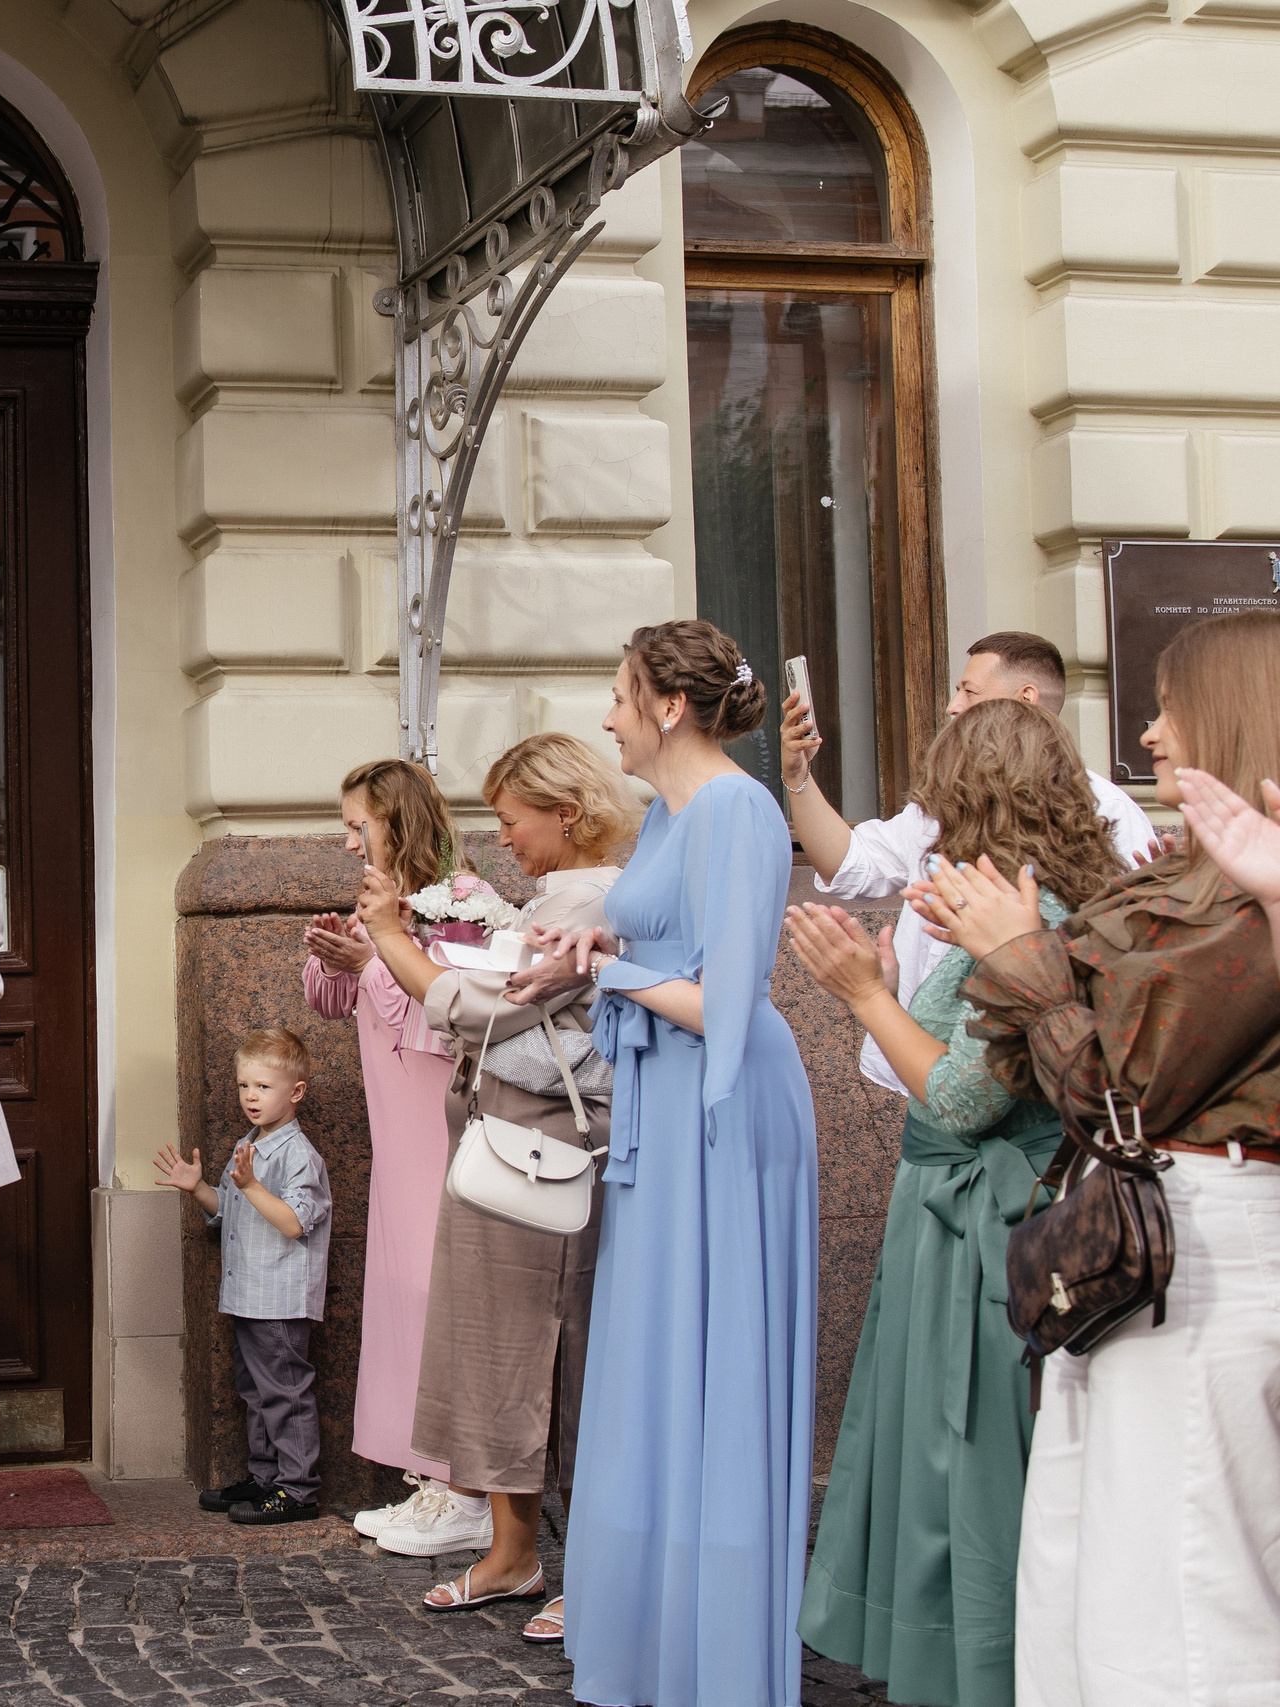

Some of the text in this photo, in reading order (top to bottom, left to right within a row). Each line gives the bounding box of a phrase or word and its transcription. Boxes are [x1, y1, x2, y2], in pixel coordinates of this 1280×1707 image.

[1213, 597, 1278, 605] ПРАВИТЕЛЬСТВО
[1154, 606, 1192, 614] КОМИТЕТ
[1197, 606, 1209, 614] ПО
[1212, 607, 1240, 615] ДЕЛАМ
